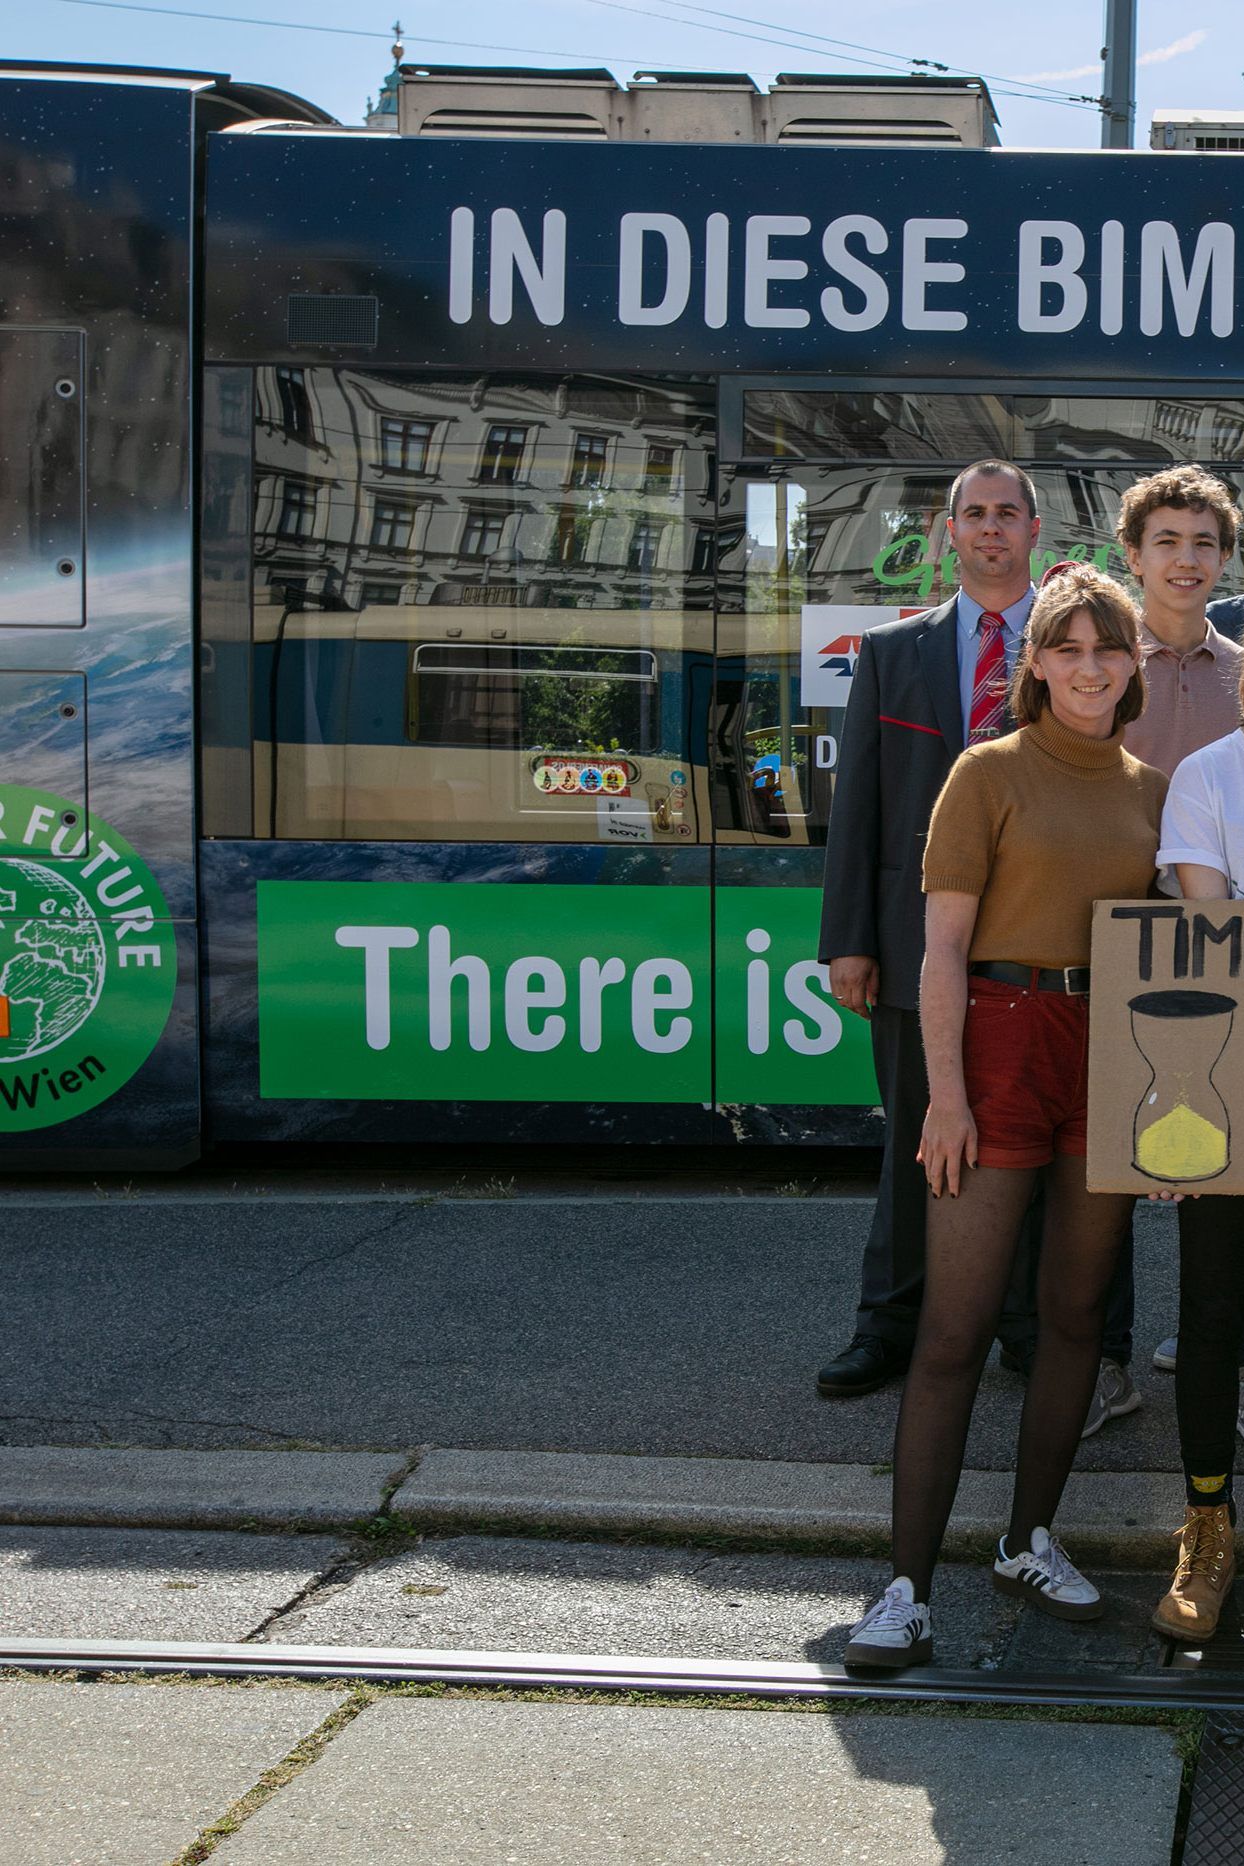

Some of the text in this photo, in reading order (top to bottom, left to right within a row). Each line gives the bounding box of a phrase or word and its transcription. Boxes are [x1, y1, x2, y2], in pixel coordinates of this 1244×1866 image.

[449, 206, 567, 326] IN
[618, 212, 968, 332] DIESE
[1018, 219, 1235, 338] BIM
[23, 805, 162, 968] FUTURE
[335, 924, 843, 1055] There is
[0, 1054, 107, 1111] Wien
